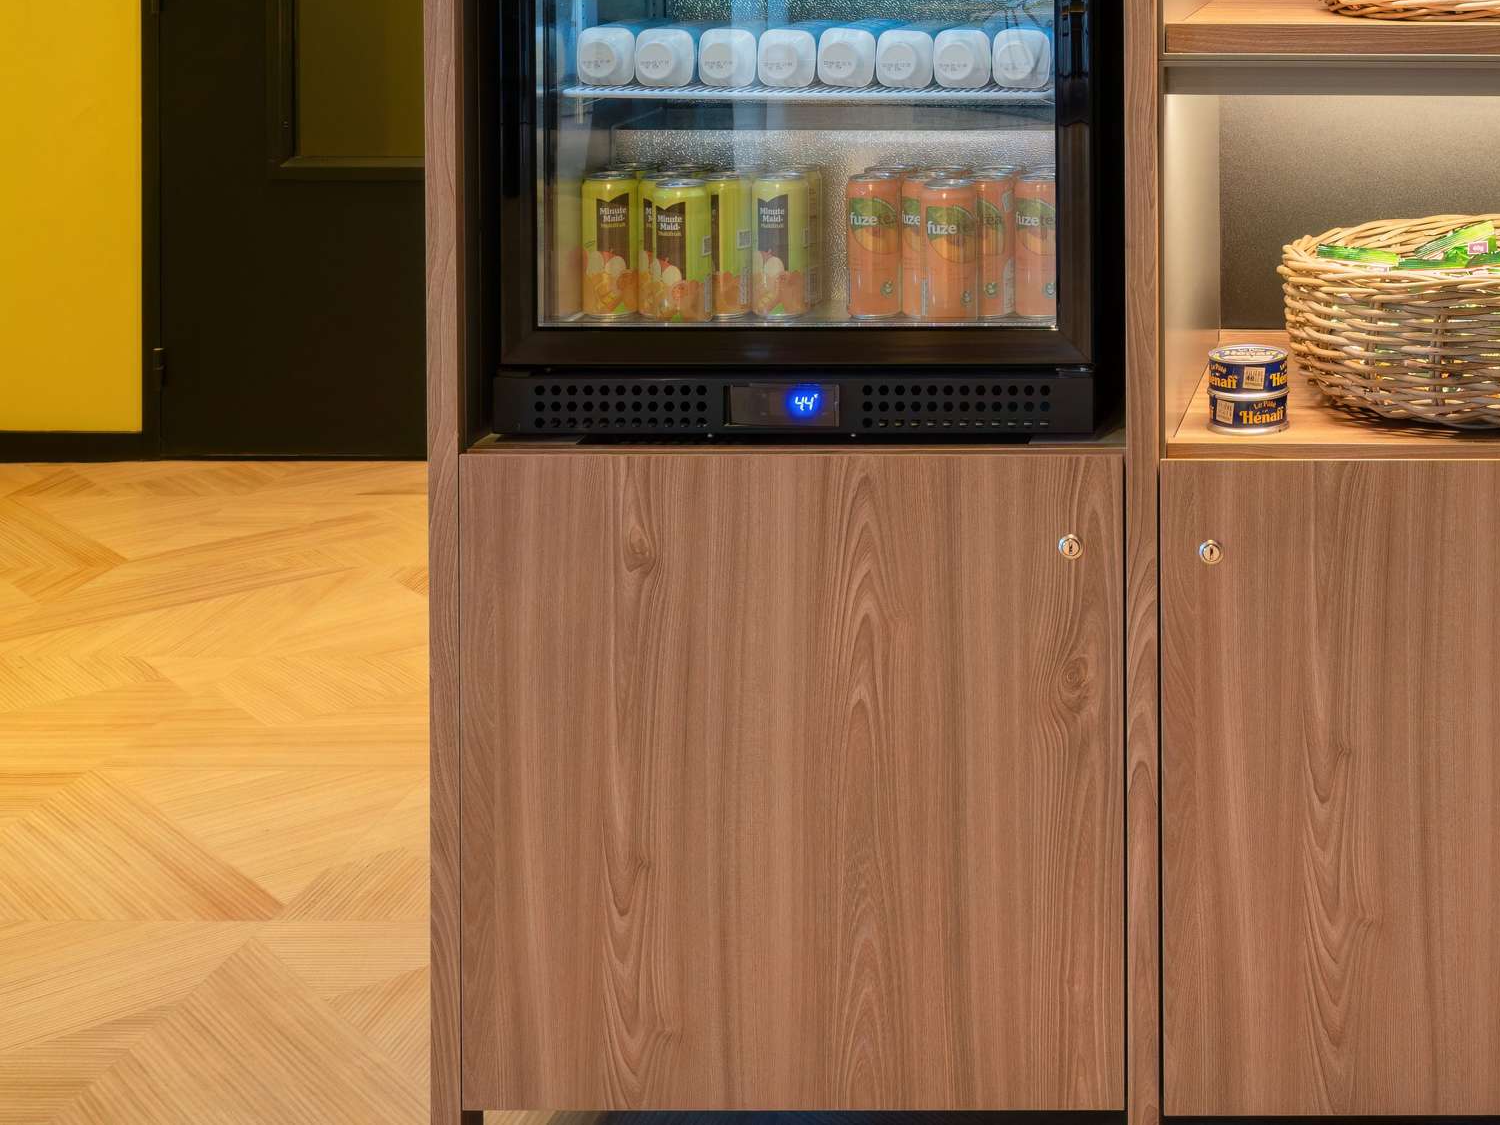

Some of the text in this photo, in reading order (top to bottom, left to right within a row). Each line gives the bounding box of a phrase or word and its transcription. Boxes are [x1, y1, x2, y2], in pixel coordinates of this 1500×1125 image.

[599, 206, 626, 215] Minute
[760, 207, 785, 215] Minute
[603, 214, 621, 222] Maid
[657, 215, 683, 223] Minute
[762, 214, 780, 222] Maid
[850, 212, 878, 226] fuze
[1015, 212, 1040, 225] fuze
[660, 223, 677, 231] Maid
[927, 221, 957, 235] fuze
[1209, 375, 1238, 389] énaff
[1240, 407, 1285, 425] Hénaff
